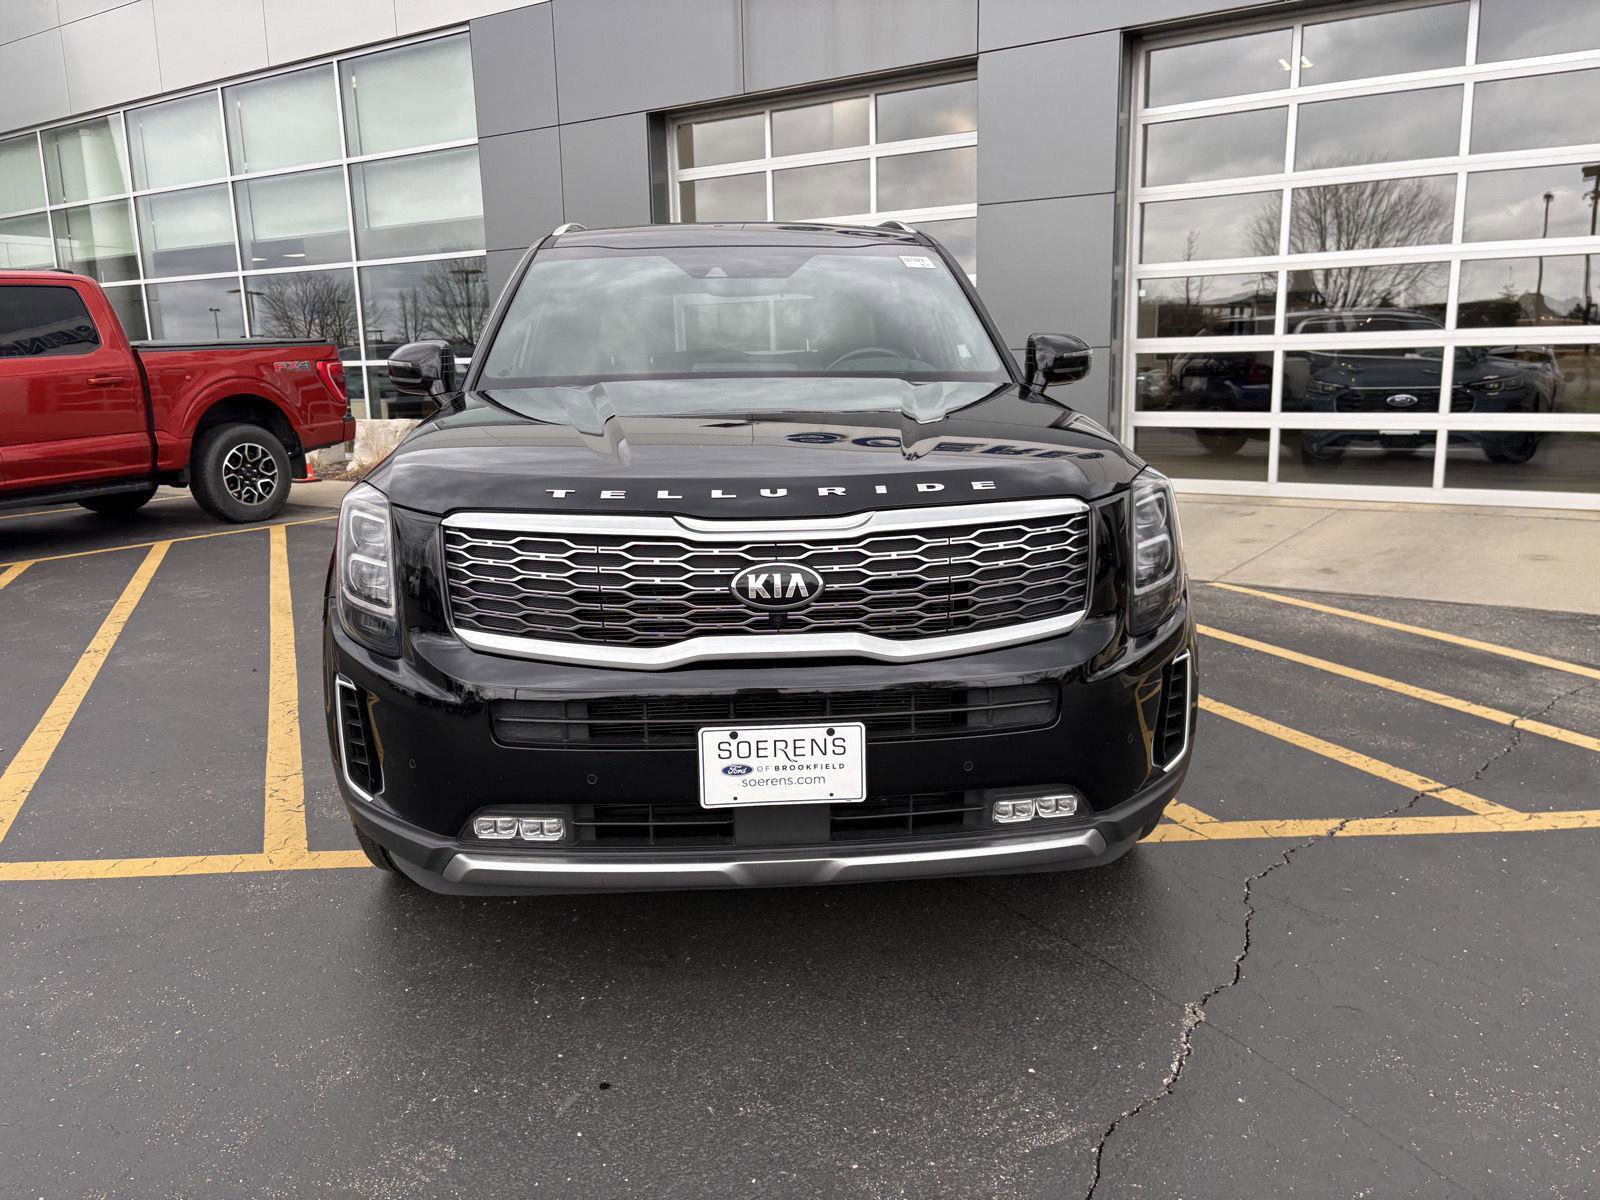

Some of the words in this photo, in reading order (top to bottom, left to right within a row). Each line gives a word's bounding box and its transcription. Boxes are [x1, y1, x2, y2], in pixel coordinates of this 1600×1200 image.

[274, 361, 310, 372] FX4
[546, 481, 997, 500] TELLURIDE
[746, 572, 809, 599] KIA
[717, 737, 847, 763] SOERENS
[725, 765, 750, 775] Ford
[757, 765, 771, 773] OF
[774, 763, 845, 772] BROOKFIELD
[741, 775, 826, 787] soerens.com
